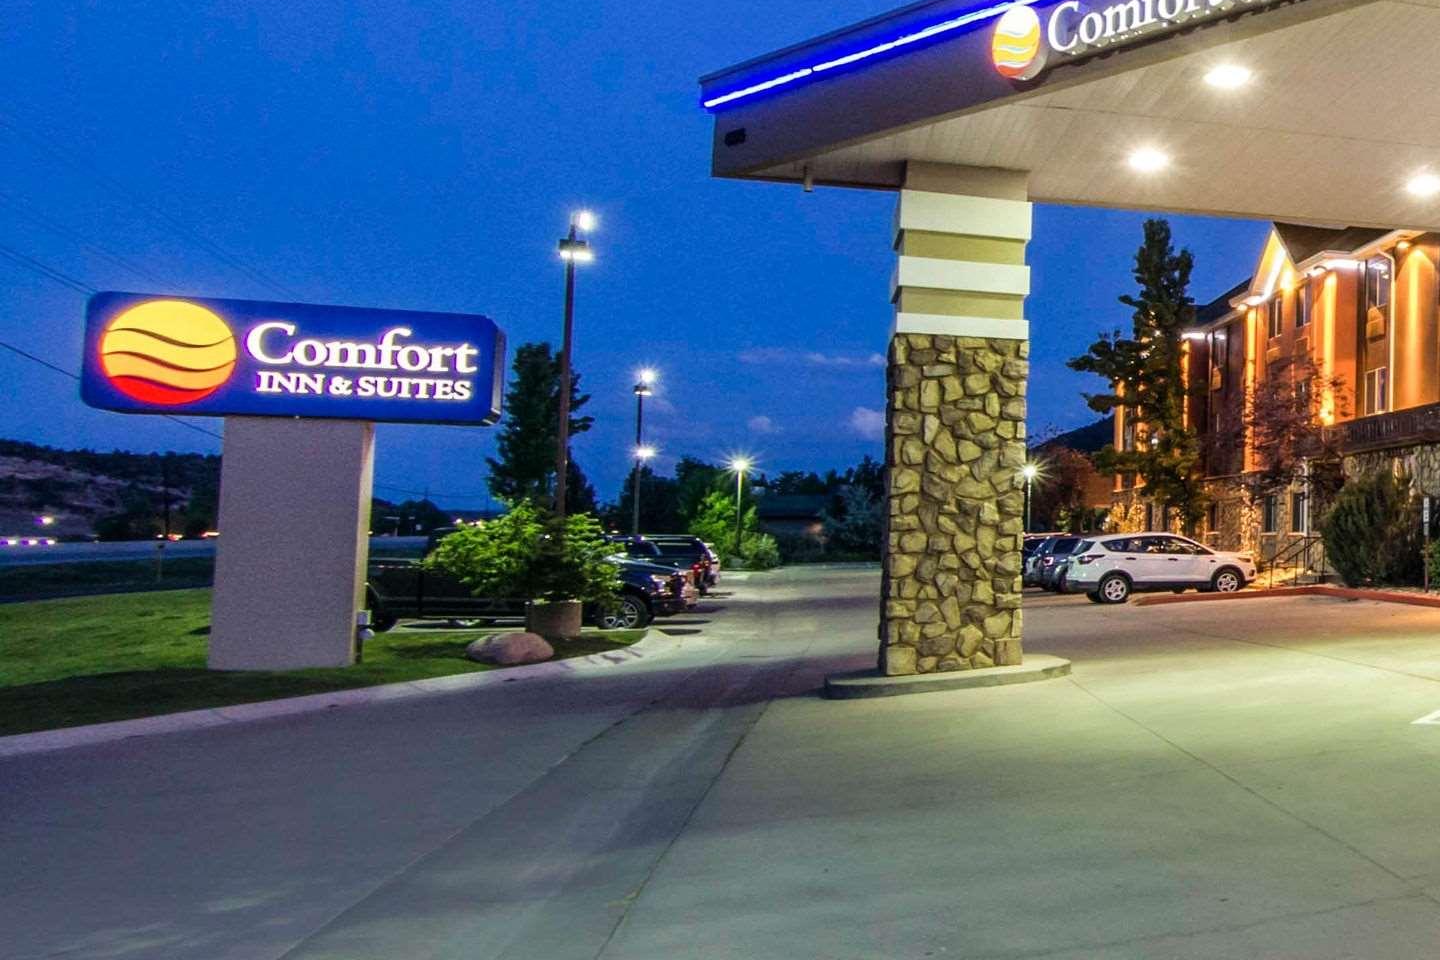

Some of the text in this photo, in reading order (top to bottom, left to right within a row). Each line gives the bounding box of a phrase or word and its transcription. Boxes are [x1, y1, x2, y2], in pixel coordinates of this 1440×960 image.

[246, 322, 477, 373] Comfort
[256, 371, 471, 400] INN & SUITES
